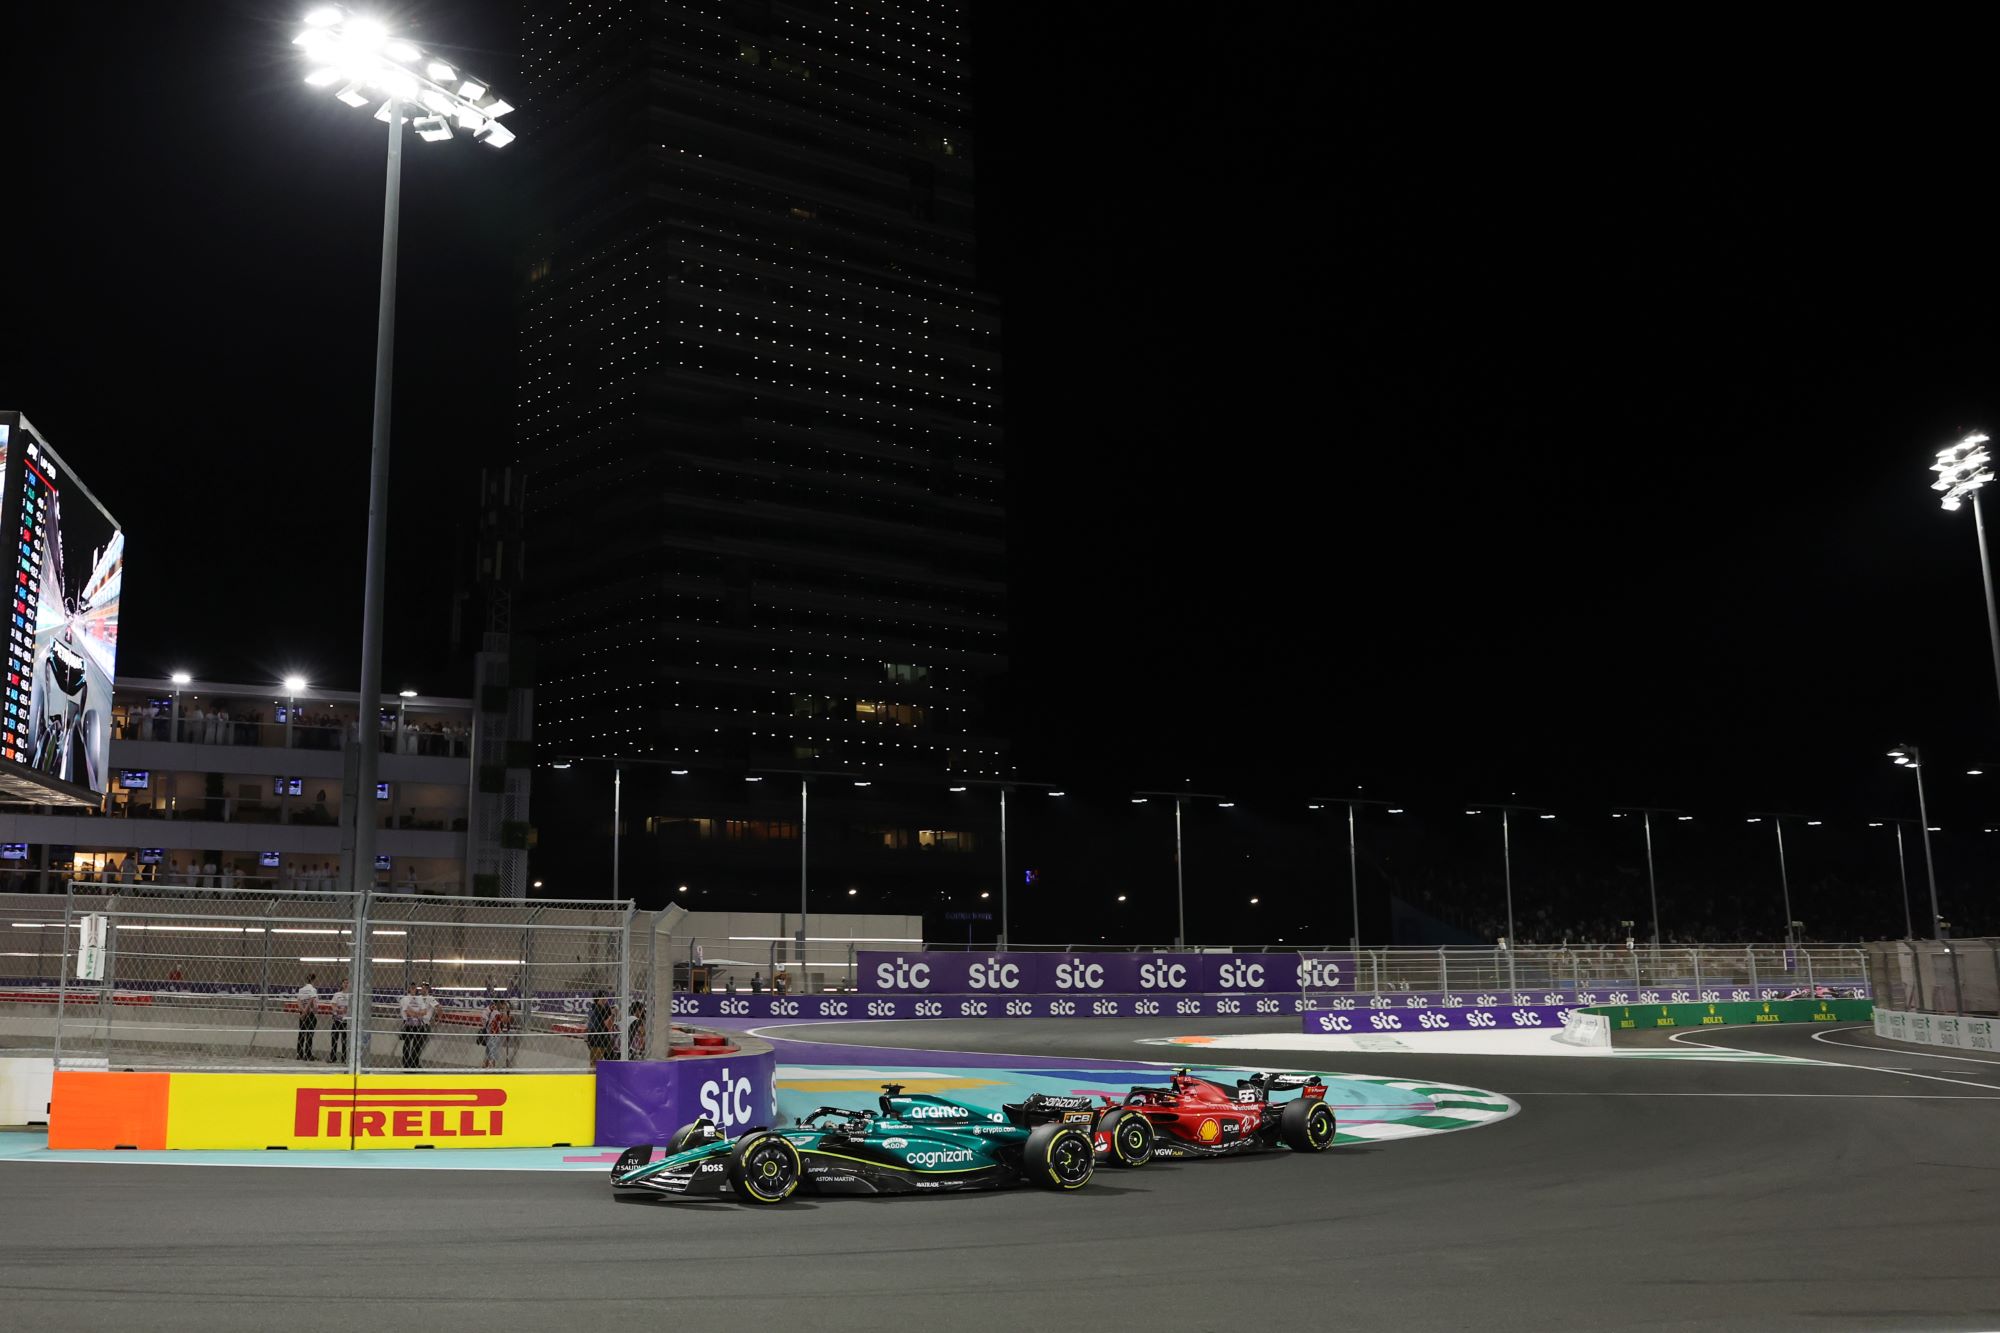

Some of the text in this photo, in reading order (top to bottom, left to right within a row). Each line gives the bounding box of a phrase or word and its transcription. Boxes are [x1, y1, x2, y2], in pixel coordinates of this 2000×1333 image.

[877, 958, 930, 989] stc
[969, 958, 1019, 989] stc
[1056, 958, 1104, 988] stc
[1140, 959, 1187, 988] stc
[1220, 959, 1265, 987] stc
[1296, 958, 1340, 987] stc
[1333, 997, 1355, 1010] stc
[1407, 995, 1428, 1008] stc
[1477, 994, 1497, 1007] stc
[1544, 992, 1564, 1006] stc
[1578, 992, 1597, 1005] stc
[1609, 991, 1629, 1004] stc
[1640, 990, 1660, 1004] stc
[1671, 990, 1690, 1003] stc
[1702, 989, 1720, 1002] stc
[1732, 989, 1750, 1002] stc
[720, 998, 749, 1015] stc
[770, 998, 799, 1016] stc
[820, 999, 848, 1016] stc
[868, 999, 896, 1016] stc
[915, 999, 942, 1016] stc
[960, 999, 988, 1016] stc
[1006, 999, 1032, 1016] stc
[1051, 999, 1075, 1015] stc
[1093, 999, 1118, 1015] stc
[1135, 998, 1159, 1015] stc
[1177, 998, 1200, 1014] stc
[1217, 998, 1240, 1013] stc
[1257, 997, 1280, 1013] stc
[1319, 1013, 1352, 1032] stc
[1370, 1012, 1402, 1030] stc
[1418, 1011, 1450, 1029] stc
[1466, 1010, 1496, 1027] stc
[1512, 1009, 1542, 1026] stc
[1703, 1016, 1723, 1024] ROLEX
[1756, 1014, 1779, 1022] ROLEX
[1814, 1013, 1837, 1021] ROLEX
[700, 1068, 752, 1127] stc
[1238, 1089, 1256, 1103] 55
[294, 1088, 507, 1137] PIRELLI
[912, 1106, 968, 1119] aramco
[1065, 1114, 1091, 1123] JCB
[983, 1126, 1016, 1135] crypto.com
[907, 1148, 974, 1168] cognizant
[1154, 1148, 1173, 1156] VGW
[702, 1164, 724, 1172] BOSS
